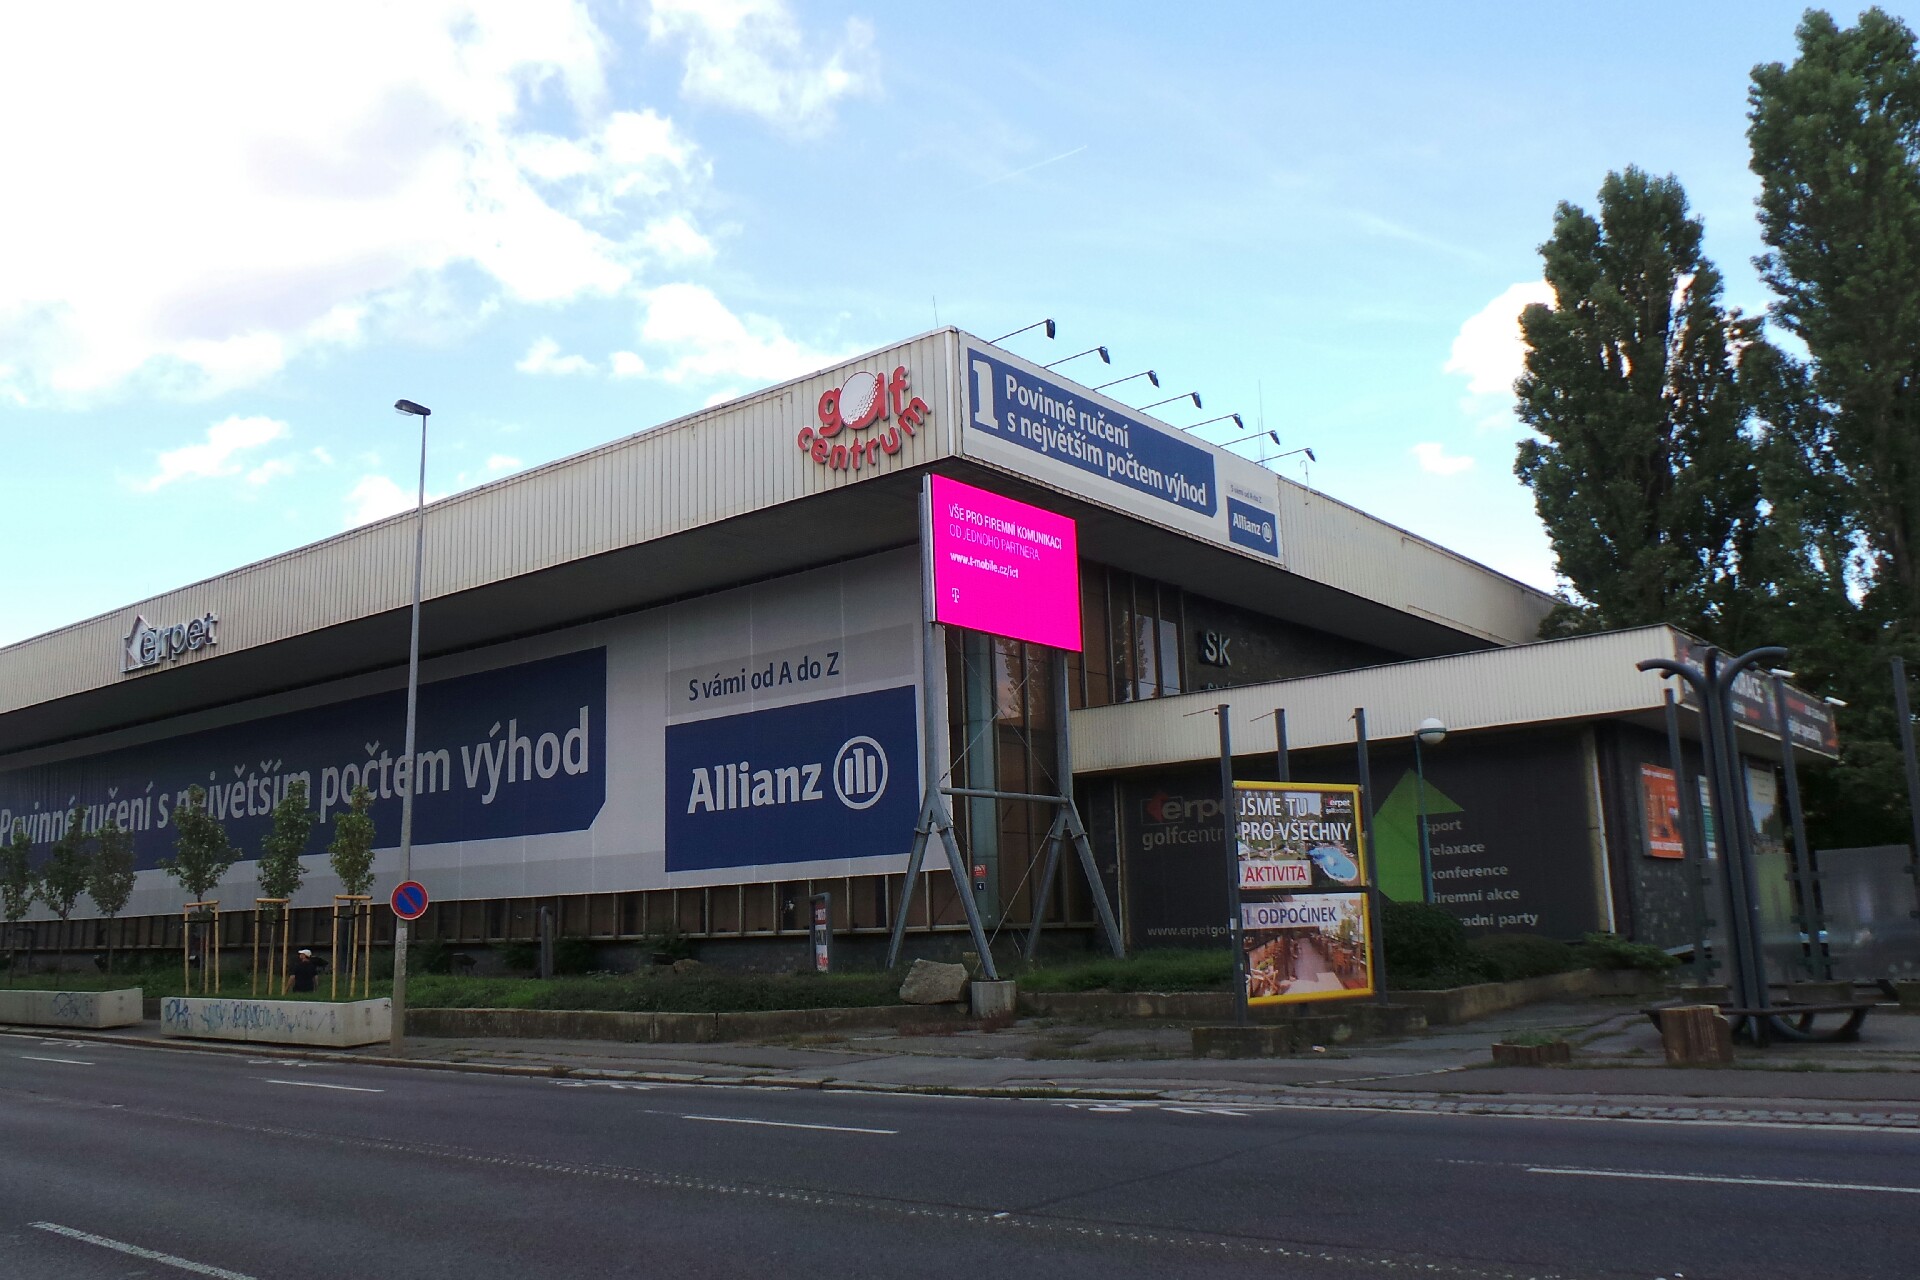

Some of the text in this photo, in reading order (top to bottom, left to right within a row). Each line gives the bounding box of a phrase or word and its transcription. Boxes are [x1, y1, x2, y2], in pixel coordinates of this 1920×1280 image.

[818, 365, 909, 438] golf
[972, 359, 999, 430] 1
[1005, 373, 1129, 449] Povinné ručení
[797, 396, 931, 470] centrum
[1007, 412, 1207, 507] s největším počtem výhod
[948, 503, 965, 521] VŠE
[965, 509, 983, 526] PRO
[984, 515, 1016, 537] FIREMNÍ
[1232, 512, 1261, 536] Allianz
[949, 523, 962, 539] OD
[963, 528, 1000, 549] JEDNOHO
[949, 552, 1019, 578] www.t-mobile.cz/ict
[139, 612, 218, 662] erpet
[689, 651, 840, 701] S vámi od A do Z
[156, 792, 169, 829] s
[460, 705, 589, 804] výhod
[687, 761, 823, 814] Allianz
[1162, 798, 1226, 823] erp
[1240, 797, 1308, 817] JSME TU
[1142, 826, 1225, 851] golfcentr
[1241, 818, 1352, 841] PRO VŠECHNY
[1245, 866, 1307, 882] AKTIVITA
[1486, 888, 1520, 901] akce
[1257, 904, 1337, 924] ODPOČINEK
[1498, 912, 1539, 928] party
